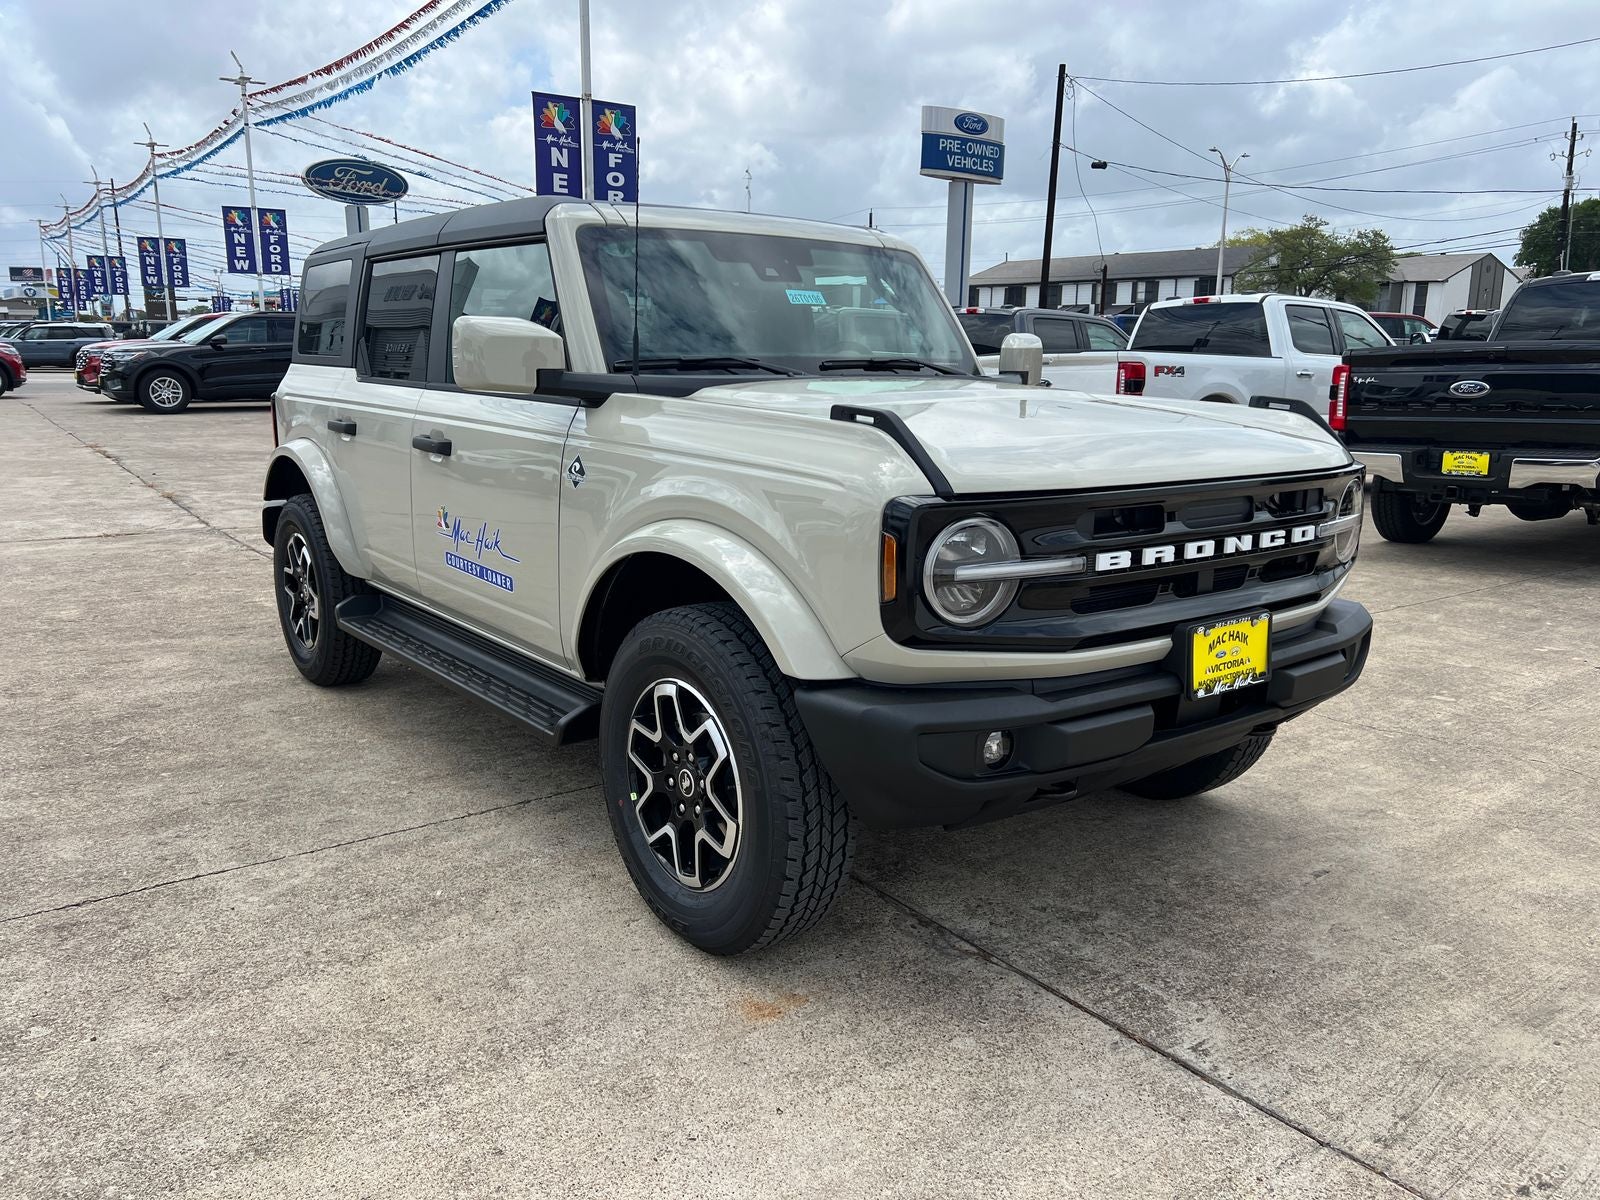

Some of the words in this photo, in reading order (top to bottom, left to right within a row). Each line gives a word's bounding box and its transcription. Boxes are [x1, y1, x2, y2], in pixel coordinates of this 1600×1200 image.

[963, 116, 982, 130] Ford
[947, 154, 994, 172] VEHICLES
[329, 166, 388, 195] Ford
[233, 233, 249, 271] NEW
[269, 235, 282, 272] FORD
[93, 270, 104, 293] NEW
[145, 256, 158, 284] NEW
[172, 257, 183, 286] FORD
[61, 280, 70, 299] NEW
[79, 281, 87, 300] FORD
[115, 271, 124, 294] FORD
[1154, 365, 1185, 378] FX4
[1459, 383, 1480, 393] Ford
[445, 516, 474, 552] Mac
[475, 522, 512, 560] Haik
[1095, 525, 1316, 572] BRONCO
[447, 553, 481, 577] COURTESY
[483, 568, 511, 590] LOANER
[1208, 631, 1227, 655] MAC
[1228, 630, 1249, 646] HAIK
[1210, 657, 1245, 674] VICTORIA
[1207, 681, 1233, 696] Mac
